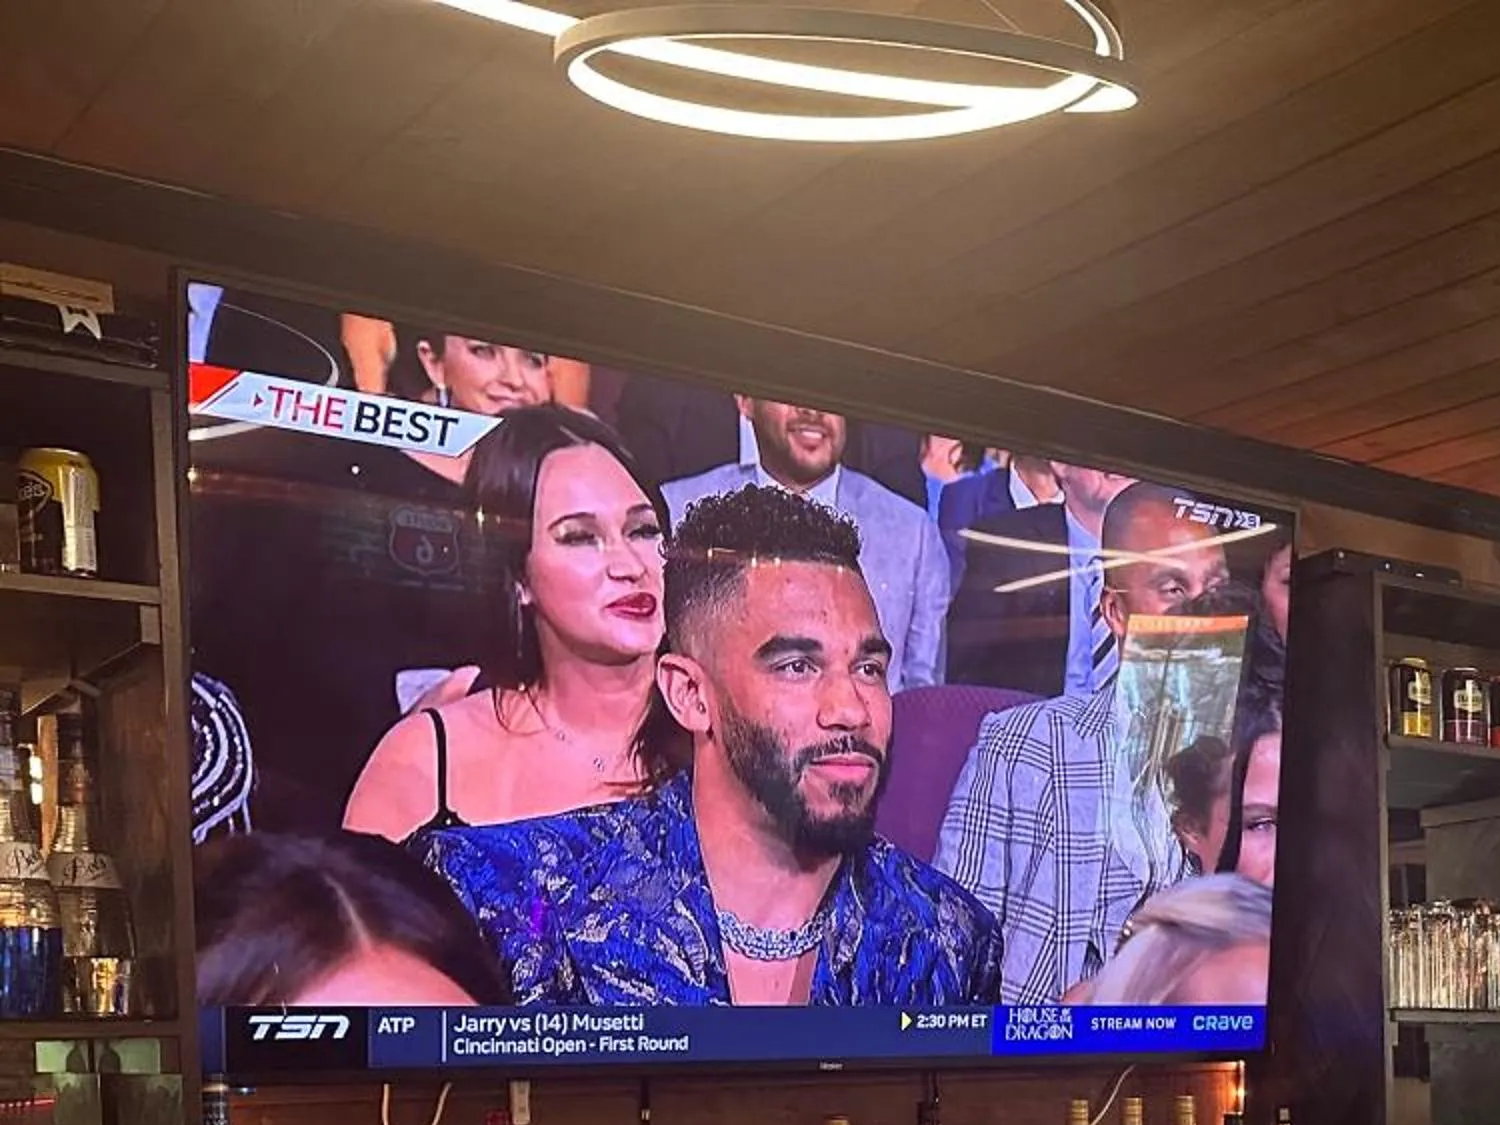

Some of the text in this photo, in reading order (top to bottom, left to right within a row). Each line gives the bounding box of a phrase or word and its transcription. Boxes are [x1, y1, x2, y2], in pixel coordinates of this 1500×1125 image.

[266, 384, 458, 447] THE BEST
[453, 1013, 645, 1036] Jarry vs (14) Musetti
[916, 1012, 988, 1029] 2:30 PM ET
[1009, 1007, 1059, 1024] HOUSE
[1090, 1017, 1177, 1031] STREAM NOW
[247, 1015, 350, 1041] TSN
[377, 1017, 416, 1034] ATP
[1004, 1023, 1074, 1041] DRAGON
[453, 1036, 541, 1056] Cincinnati
[543, 1037, 587, 1058] Open
[599, 1036, 635, 1053] First
[637, 1034, 689, 1053] Round
